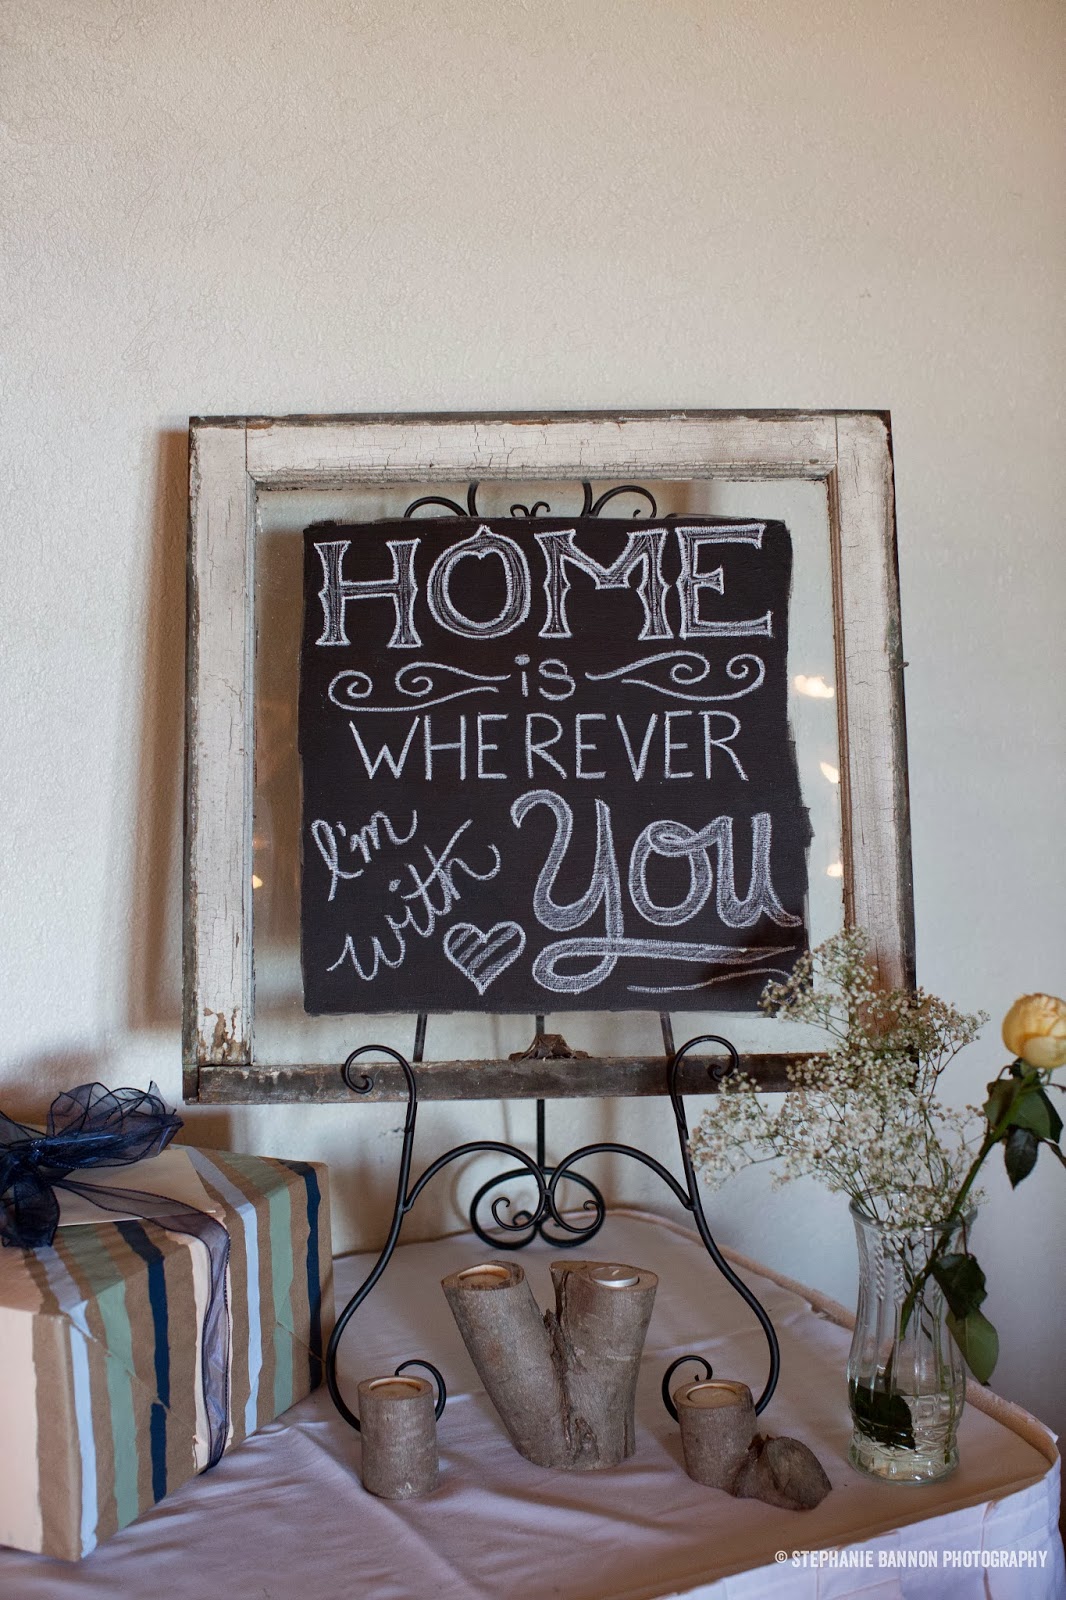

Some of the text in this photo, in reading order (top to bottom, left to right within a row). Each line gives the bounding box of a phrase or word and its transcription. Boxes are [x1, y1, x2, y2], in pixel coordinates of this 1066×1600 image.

[313, 524, 774, 648] HOME
[514, 654, 576, 701] is
[349, 710, 750, 782] WHEREVER
[310, 809, 418, 902] I'm
[326, 818, 502, 982] with
